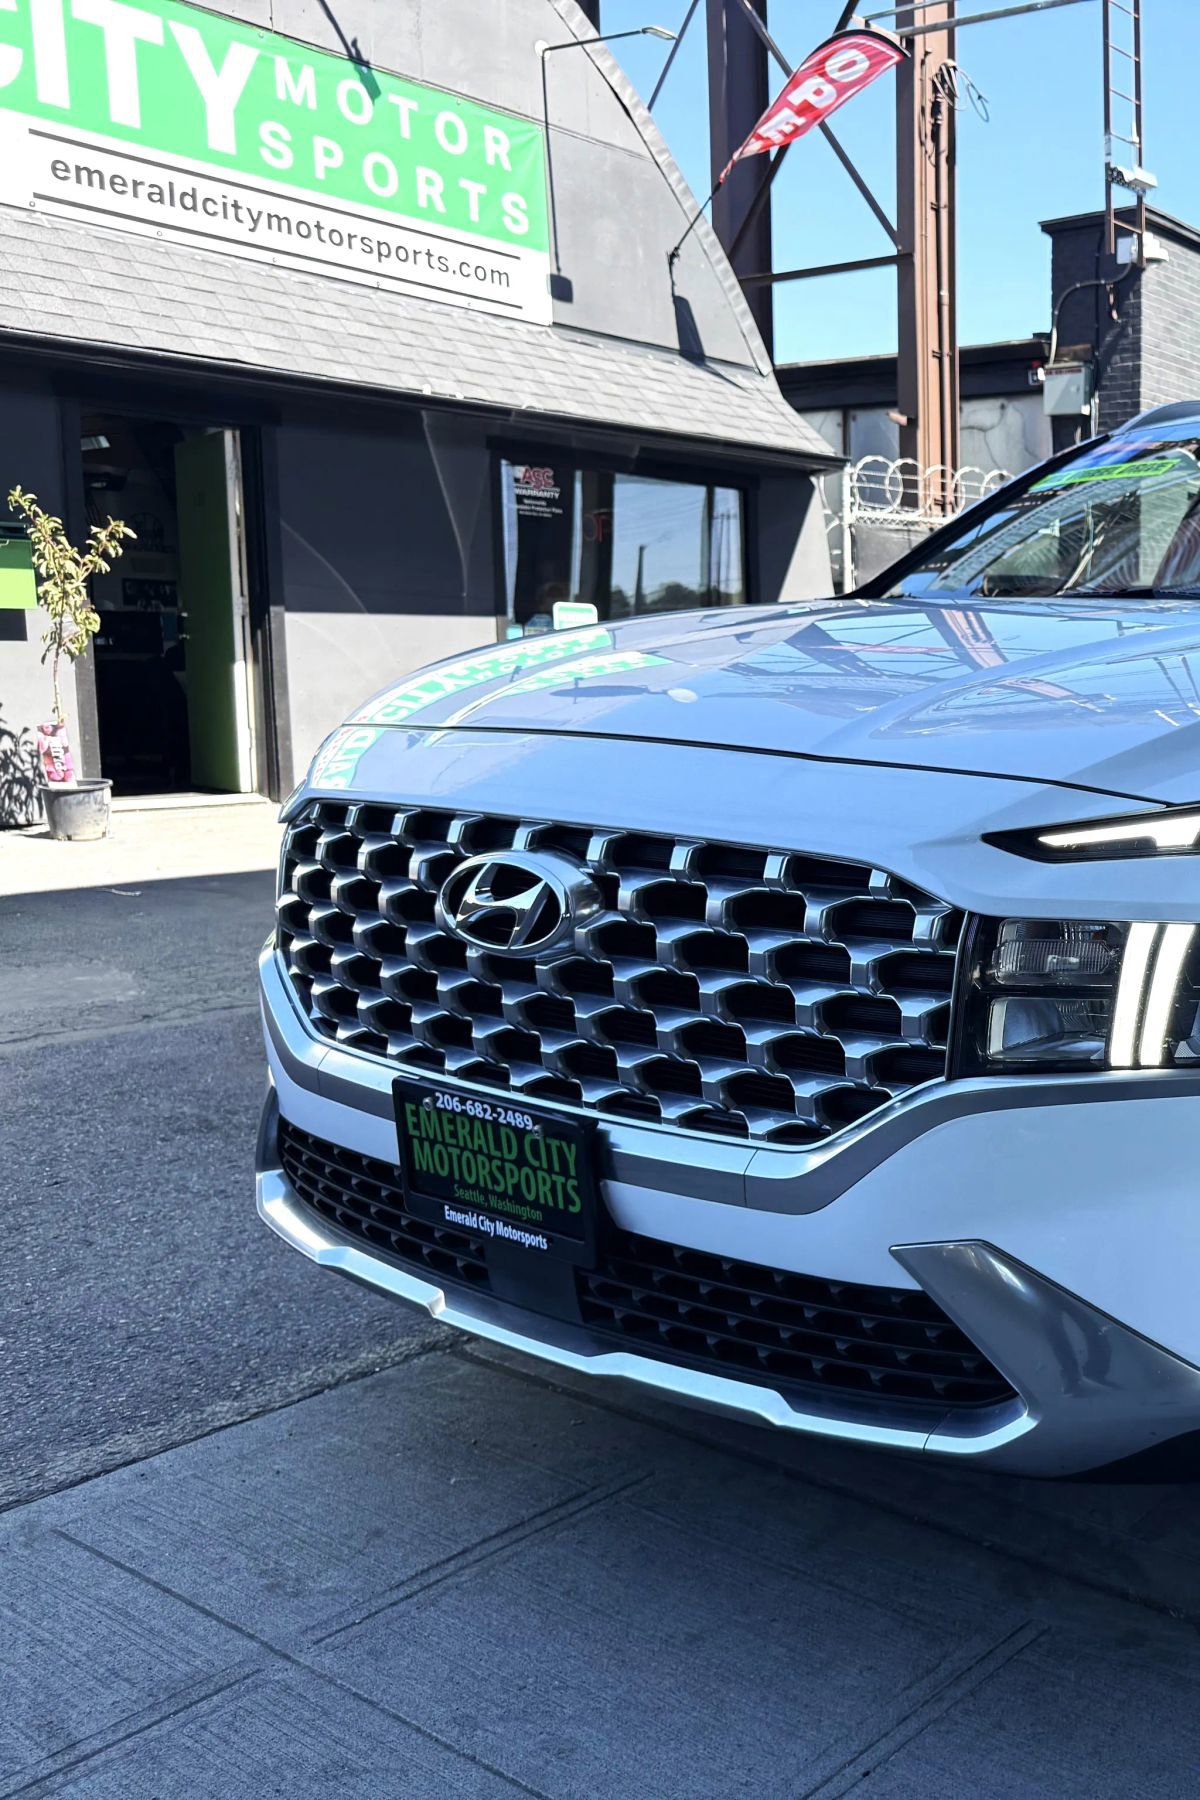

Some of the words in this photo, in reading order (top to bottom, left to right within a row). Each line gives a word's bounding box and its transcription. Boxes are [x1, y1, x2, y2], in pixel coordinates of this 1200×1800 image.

[275, 57, 512, 171] MOTOR
[259, 120, 530, 235] SPORTS
[50, 157, 511, 288] emeraldcitymotorsports.com
[405, 1102, 518, 1160] EMERALD
[524, 1132, 577, 1177] CITY
[435, 1092, 533, 1130] 206-682-2489
[412, 1138, 582, 1213] MOTORSPORTS
[454, 1184, 488, 1208] Seattle,
[488, 1193, 543, 1221] Washington
[444, 1205, 478, 1229] Emerald
[478, 1216, 495, 1237] City
[496, 1221, 548, 1250] Motorsports
